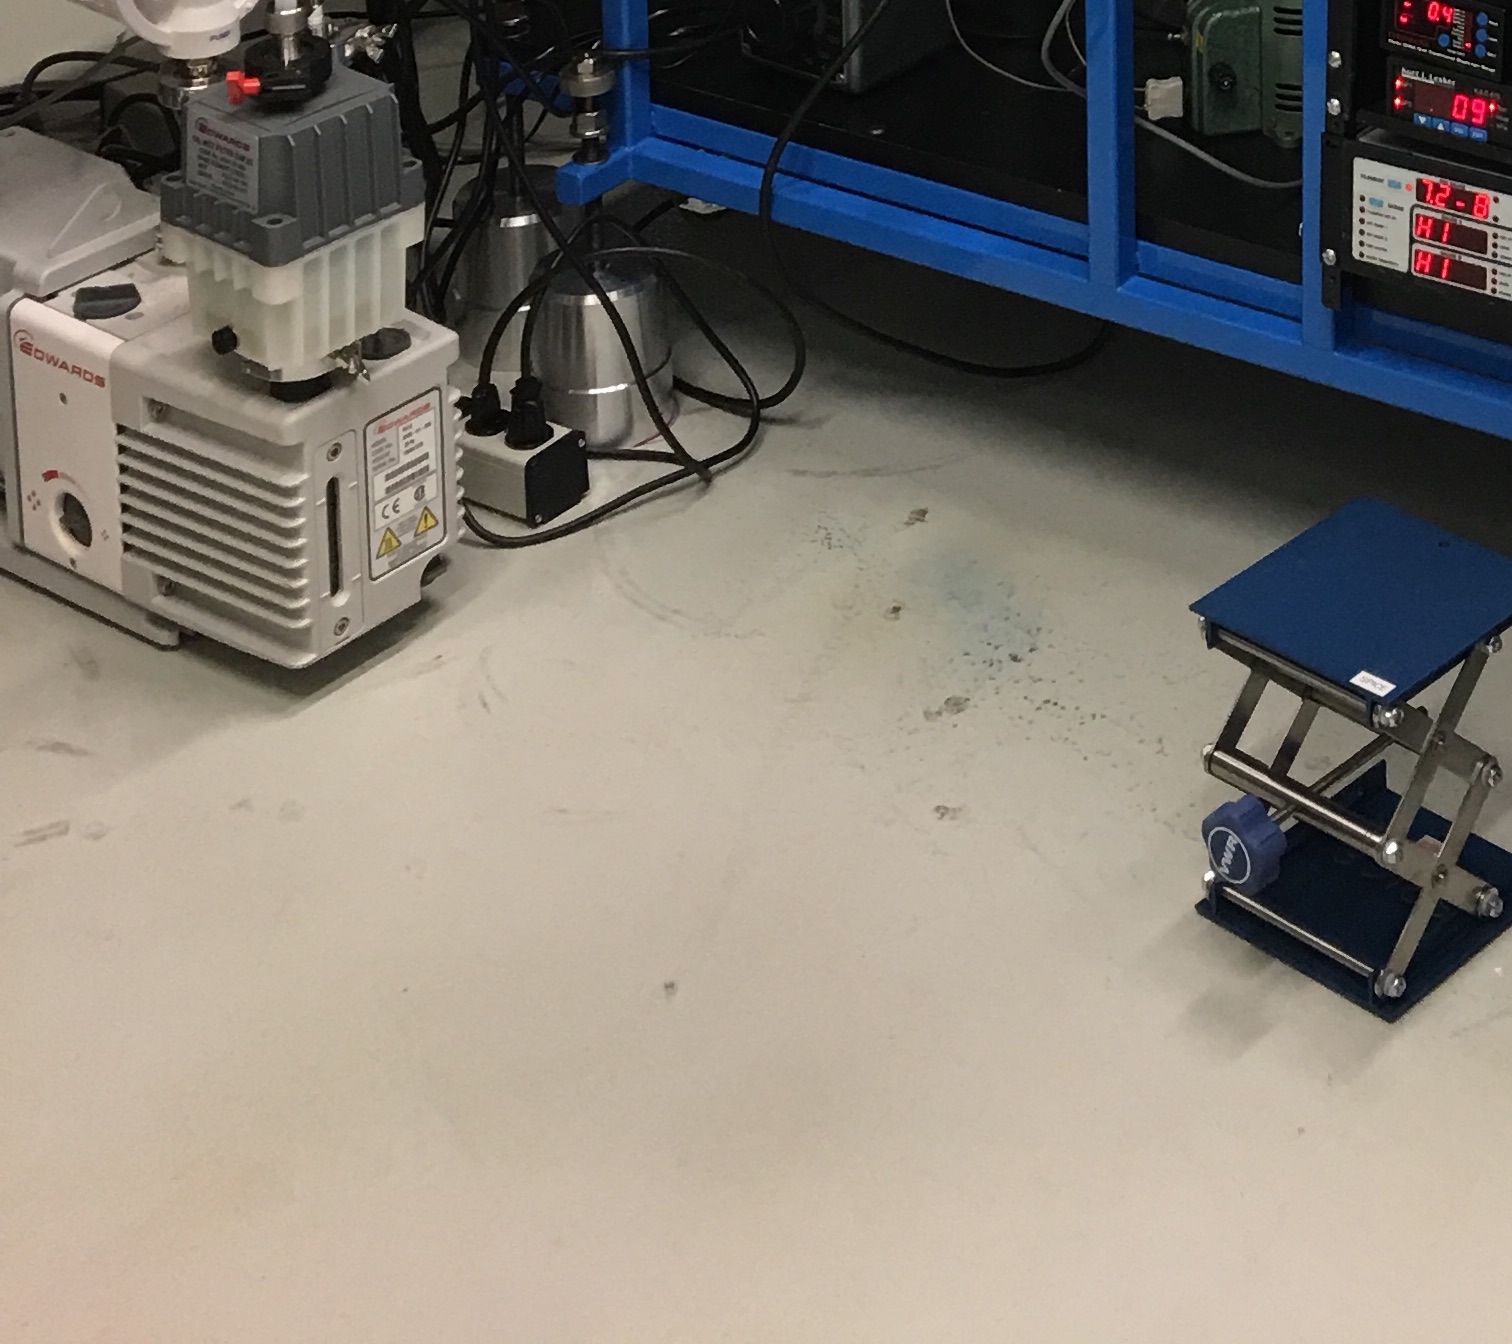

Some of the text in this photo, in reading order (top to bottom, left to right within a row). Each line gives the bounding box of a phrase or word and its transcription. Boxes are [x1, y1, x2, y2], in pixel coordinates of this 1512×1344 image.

[198, 122, 251, 152] EDWARDS
[19, 341, 106, 389] EDWARDS
[376, 401, 431, 435] EDWARDS
[1217, 834, 1239, 875] VWR
